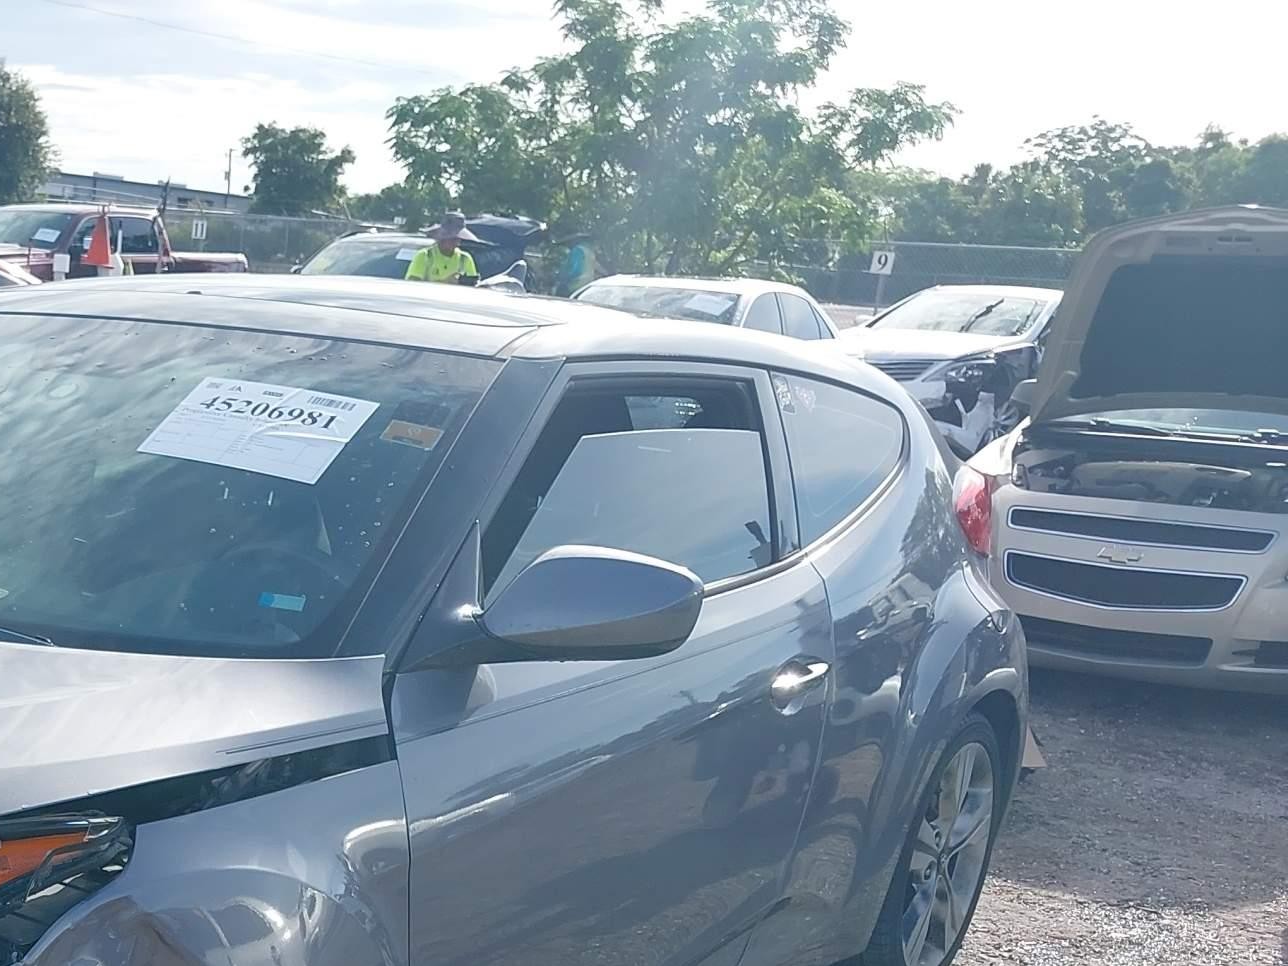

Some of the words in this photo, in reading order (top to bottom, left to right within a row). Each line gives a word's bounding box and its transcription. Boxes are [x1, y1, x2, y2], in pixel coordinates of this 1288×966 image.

[194, 223, 204, 238] 11
[877, 253, 889, 271] 9
[199, 395, 339, 430] 45206981
